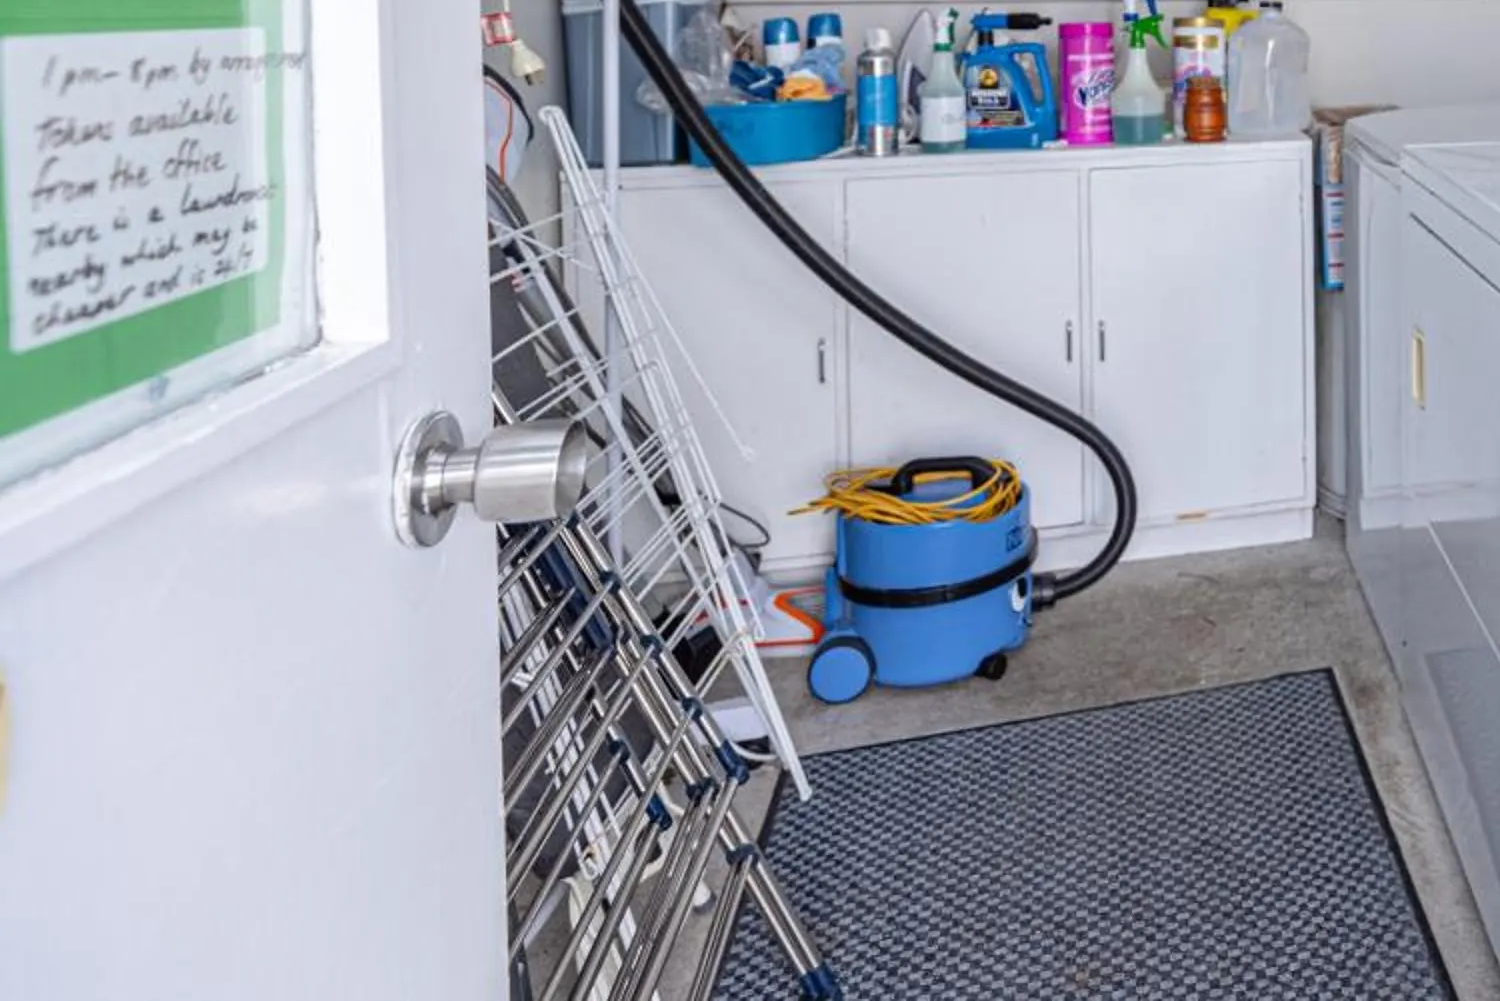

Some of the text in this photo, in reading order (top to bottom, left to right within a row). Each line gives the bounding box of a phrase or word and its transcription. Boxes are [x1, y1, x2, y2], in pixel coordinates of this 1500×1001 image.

[128, 92, 239, 137] available
[28, 137, 228, 212] from the office
[32, 223, 102, 257] There
